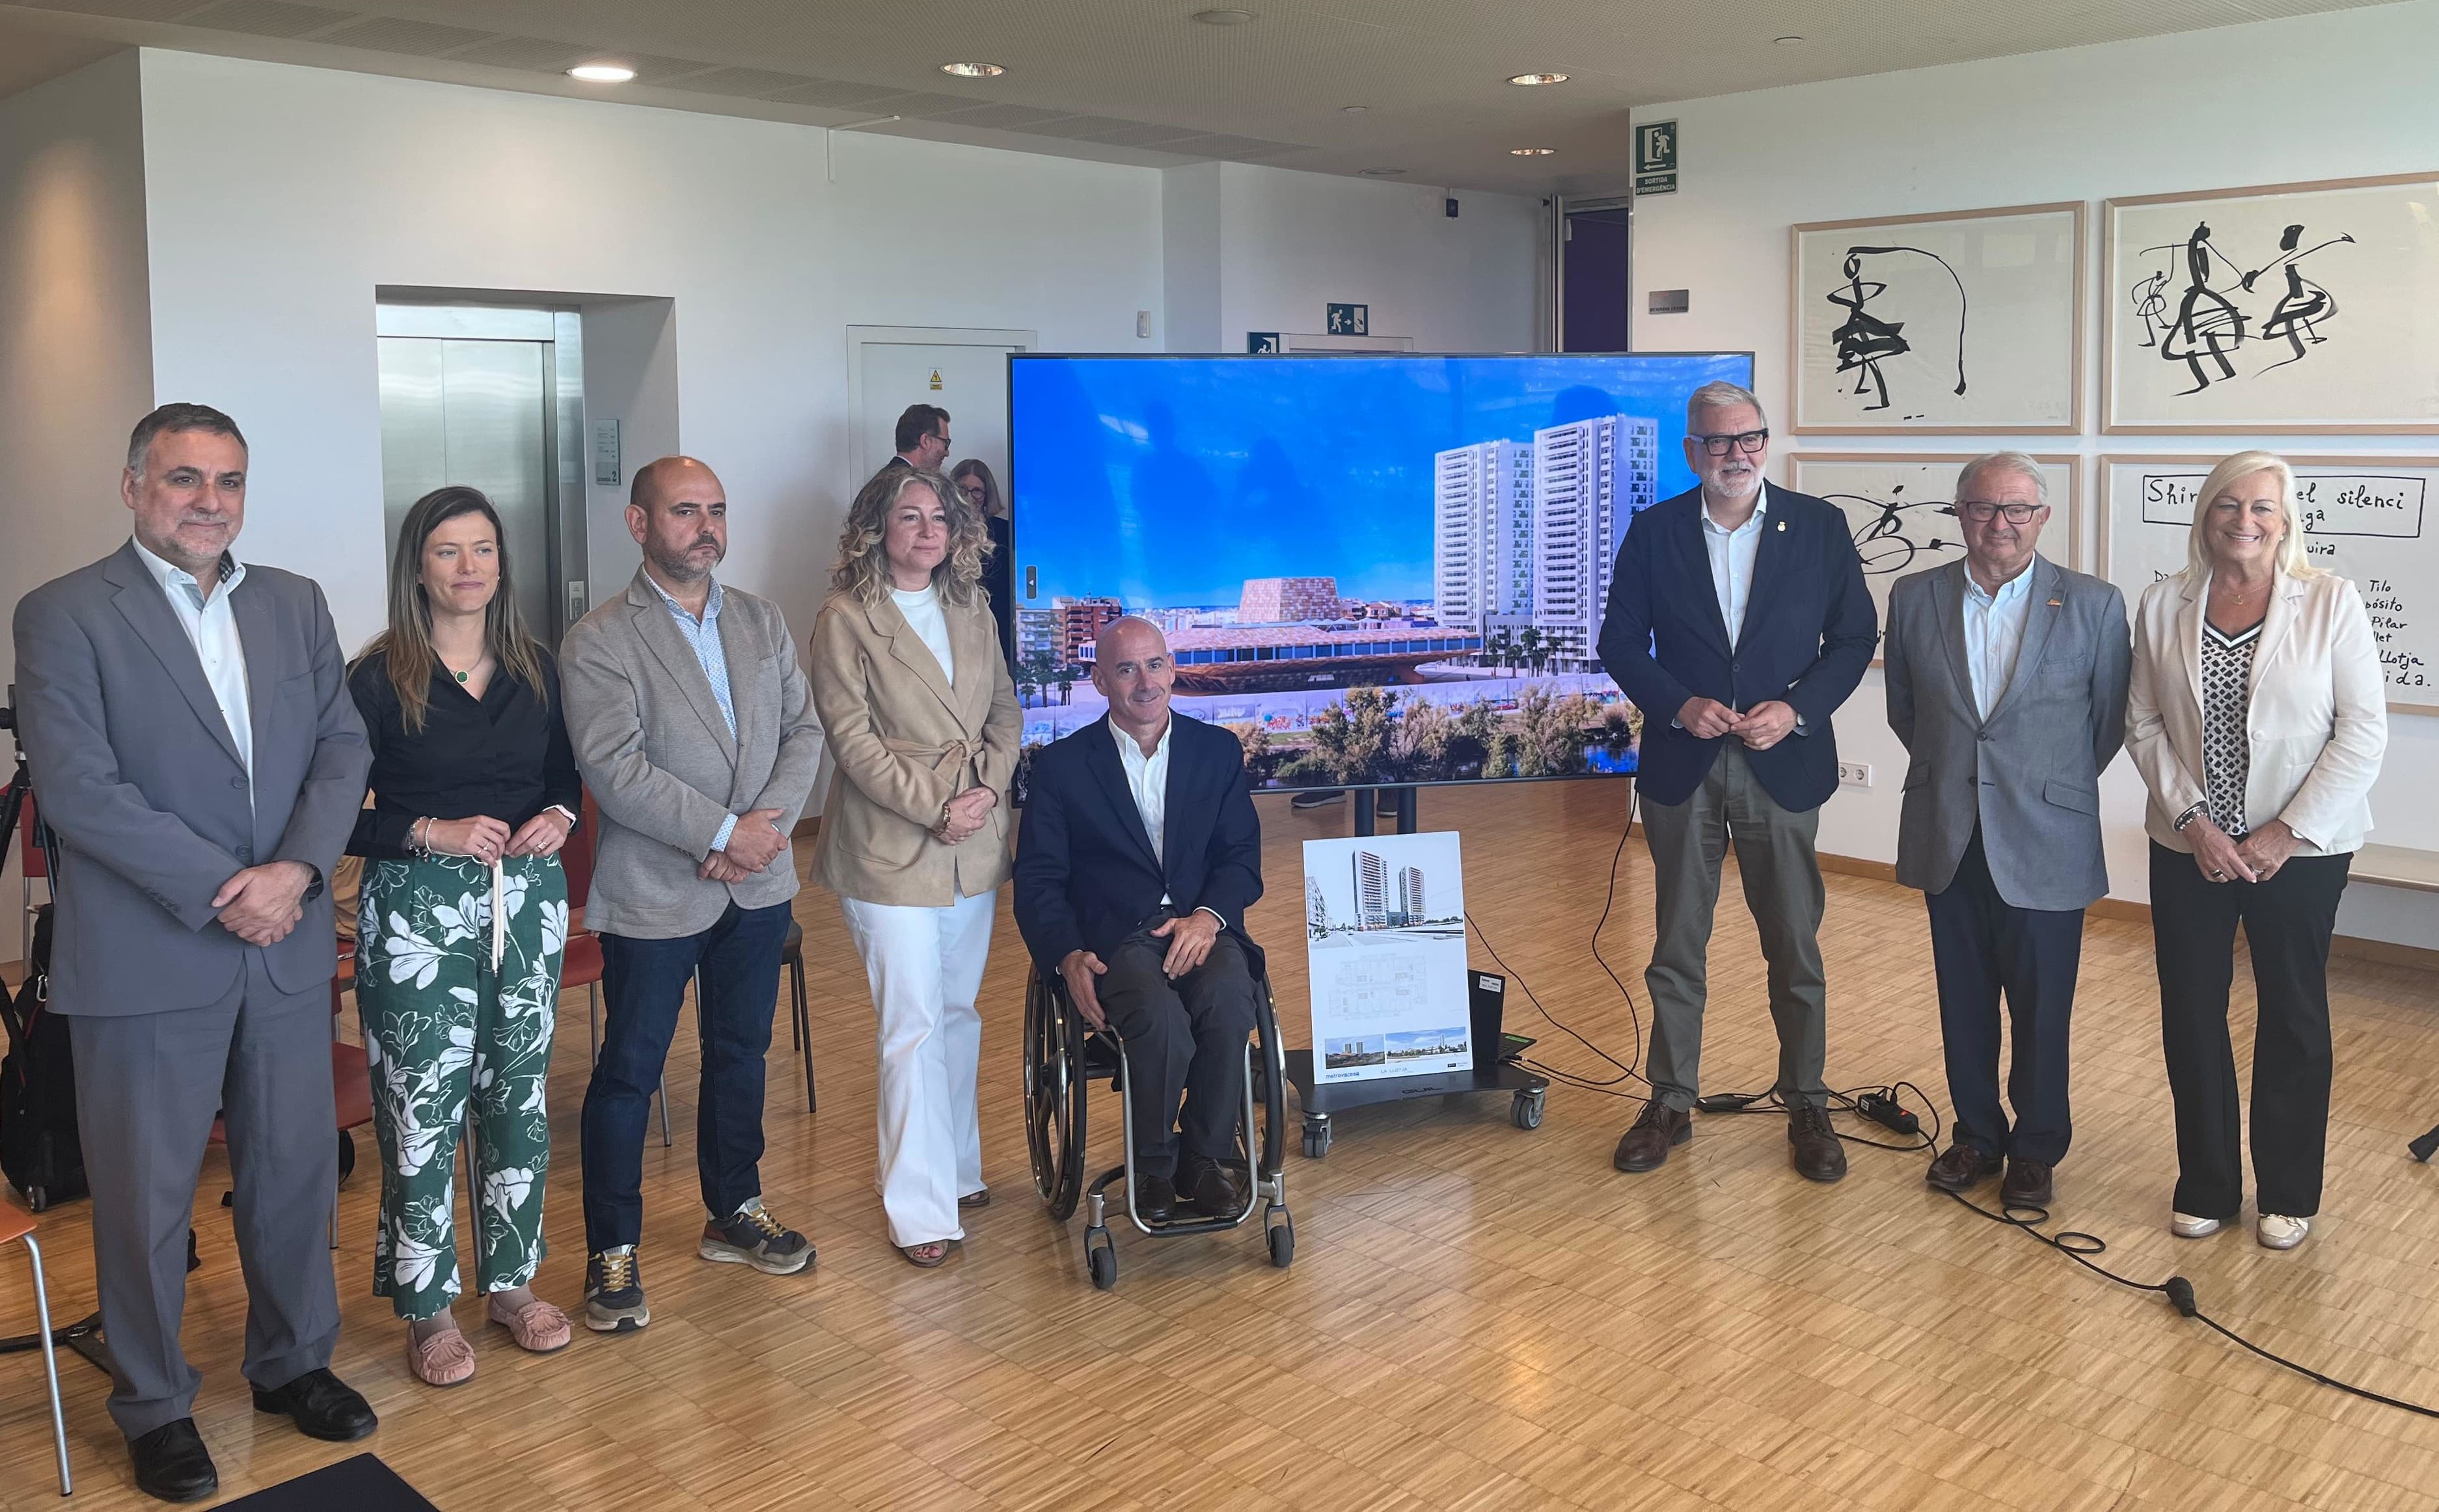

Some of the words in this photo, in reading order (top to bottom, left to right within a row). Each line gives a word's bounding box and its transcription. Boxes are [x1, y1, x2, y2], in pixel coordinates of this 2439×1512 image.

[1644, 176, 1668, 185] SORTIDA
[2337, 485, 2404, 509] silenci
[2300, 509, 2325, 531] ga
[2369, 580, 2391, 592] Tilo
[2371, 616, 2408, 629] Pilar
